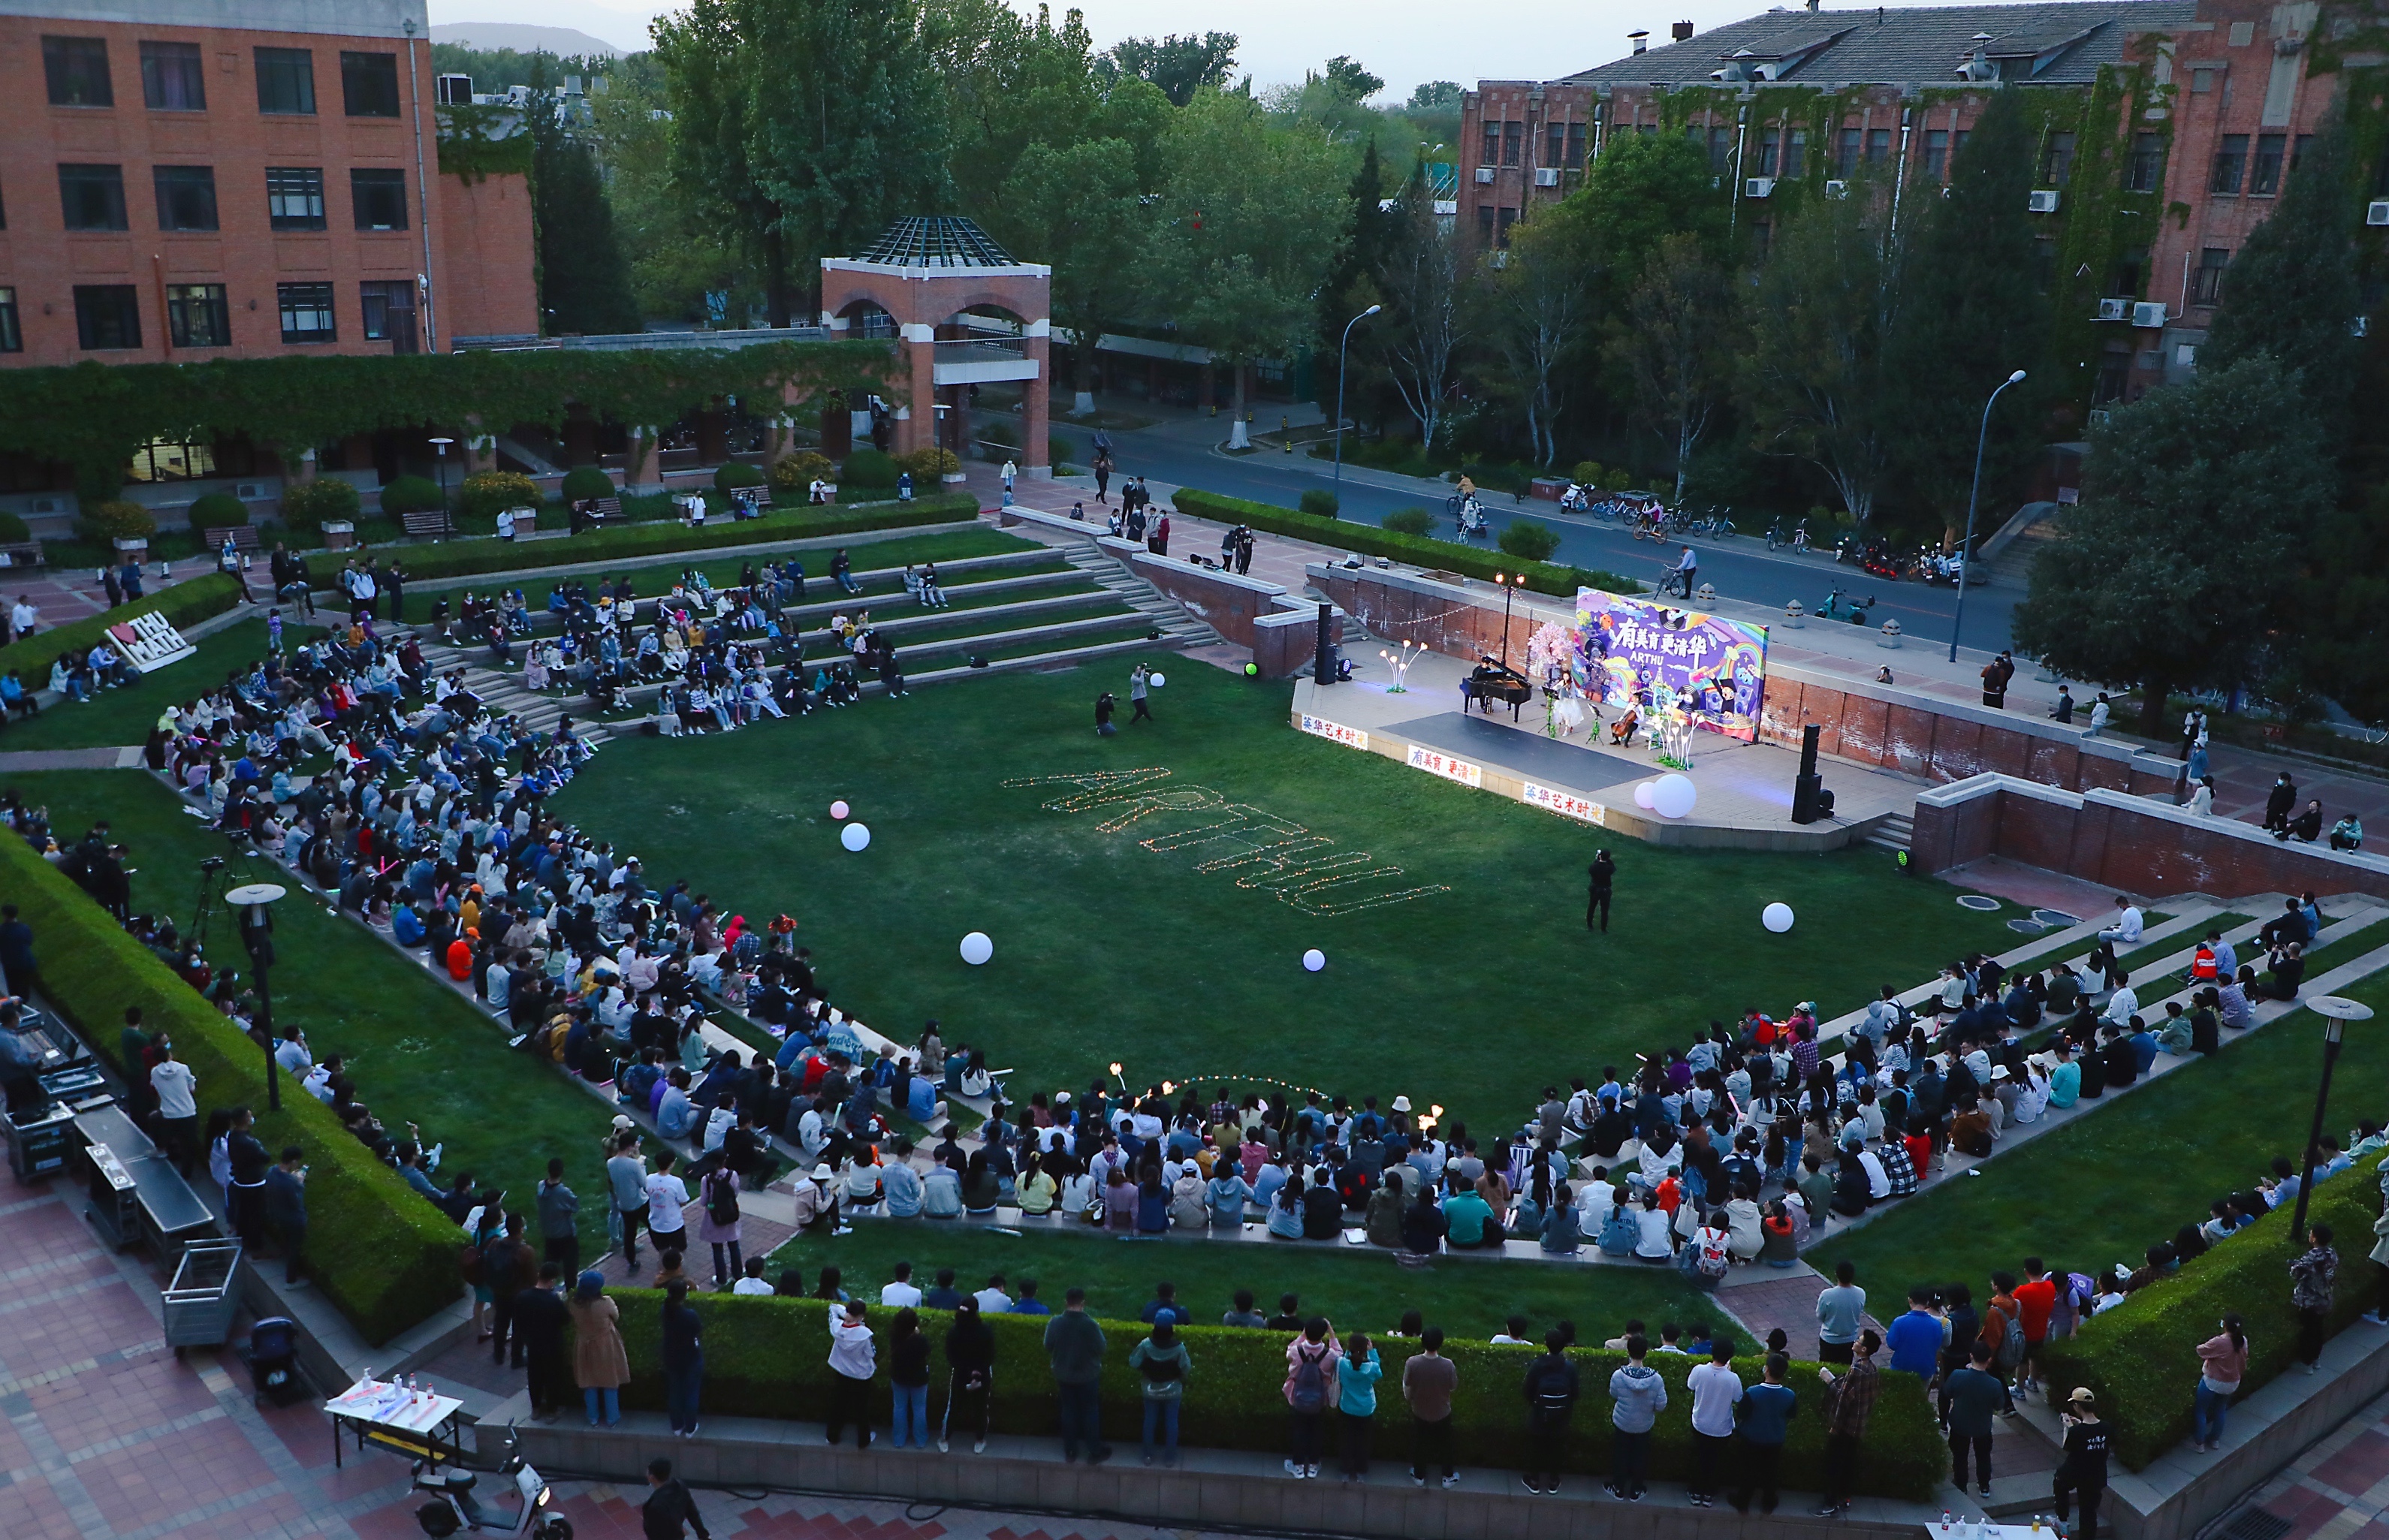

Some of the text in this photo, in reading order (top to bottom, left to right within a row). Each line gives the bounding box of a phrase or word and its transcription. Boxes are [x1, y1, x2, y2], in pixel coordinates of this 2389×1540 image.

[127, 610, 170, 639] THU
[127, 626, 188, 665] MATH
[1630, 651, 1664, 666] ARTHU
[1303, 716, 1366, 748] 英华艺术时光
[1411, 749, 1479, 785] 有美育 更清华
[1525, 785, 1603, 822] 英华艺术时光
